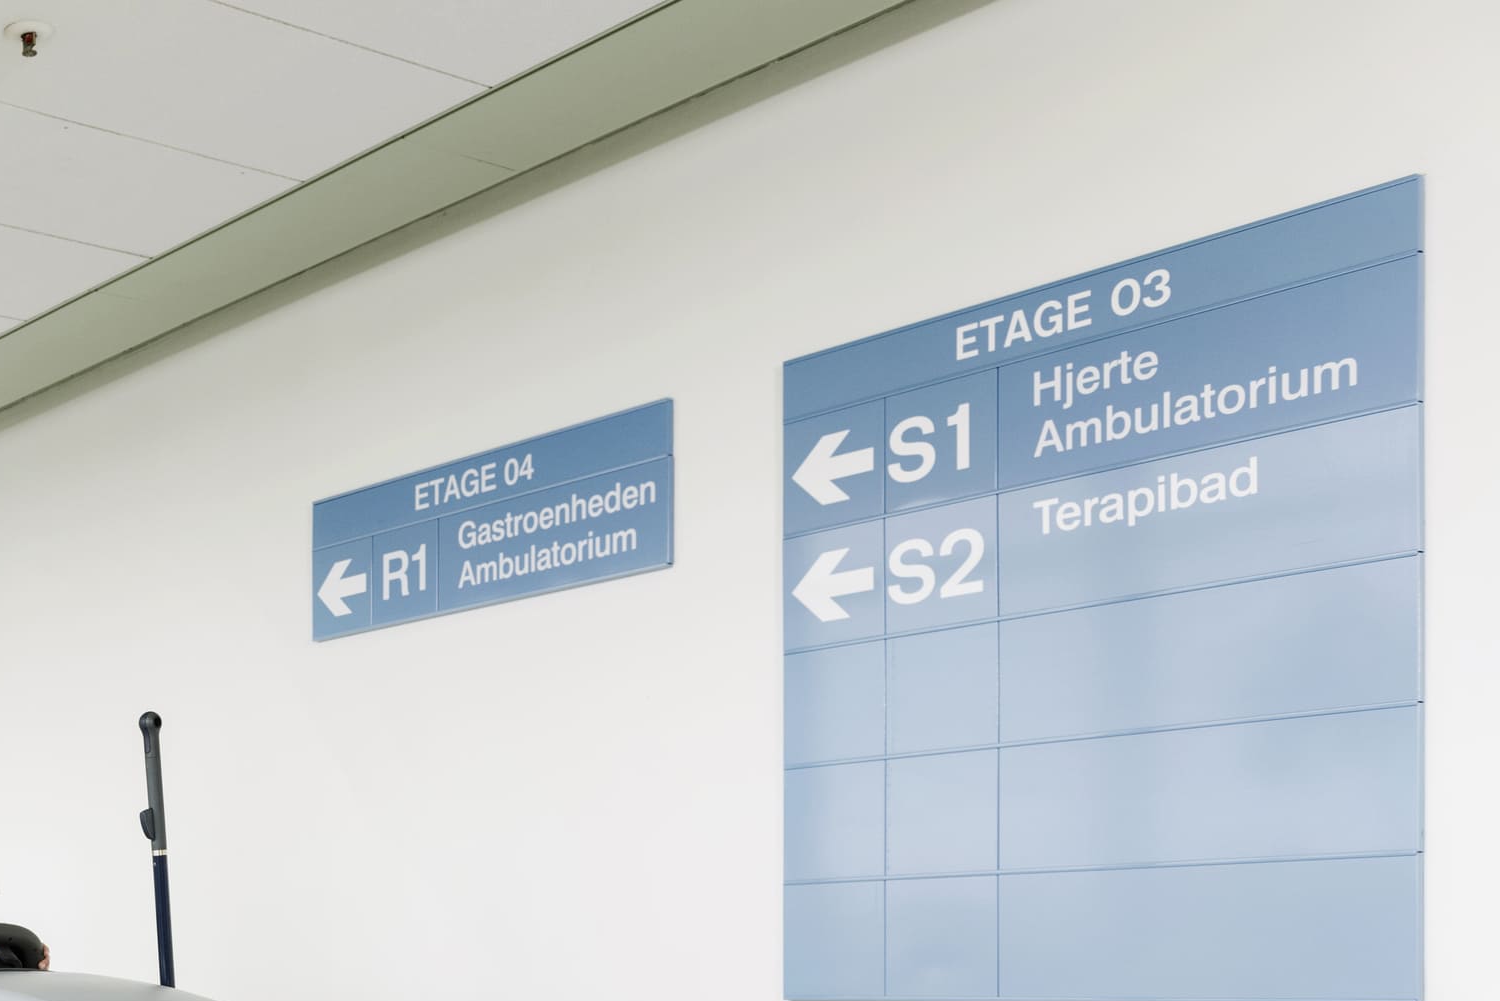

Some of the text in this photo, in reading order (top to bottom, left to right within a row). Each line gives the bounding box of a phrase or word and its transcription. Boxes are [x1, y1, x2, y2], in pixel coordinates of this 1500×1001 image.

[954, 269, 1173, 360] ETAGE 03
[1032, 350, 1160, 408] Hjerte
[1033, 357, 1359, 458] Ambulatorium
[887, 402, 972, 483] S1
[414, 454, 534, 511] ETAGE 04
[457, 481, 657, 549] Gastroenheden
[1032, 457, 1259, 535] Terapibad
[381, 544, 428, 601] R1
[457, 527, 637, 589] Ambulatorium
[887, 528, 986, 604] S2
